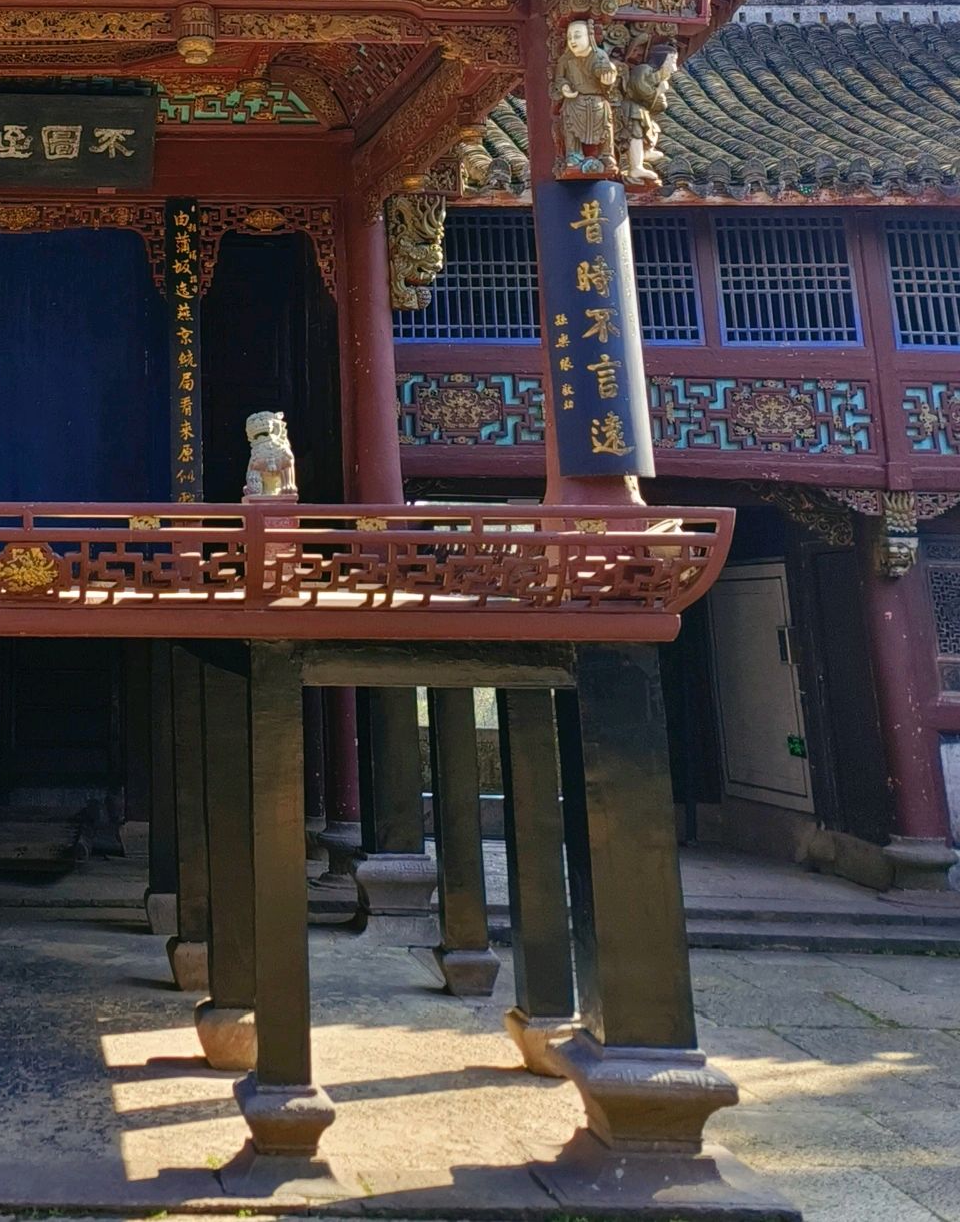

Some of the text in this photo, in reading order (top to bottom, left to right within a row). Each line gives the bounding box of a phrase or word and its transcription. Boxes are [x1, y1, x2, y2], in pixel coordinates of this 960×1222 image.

[569, 199, 636, 457] 昔時不言遠
